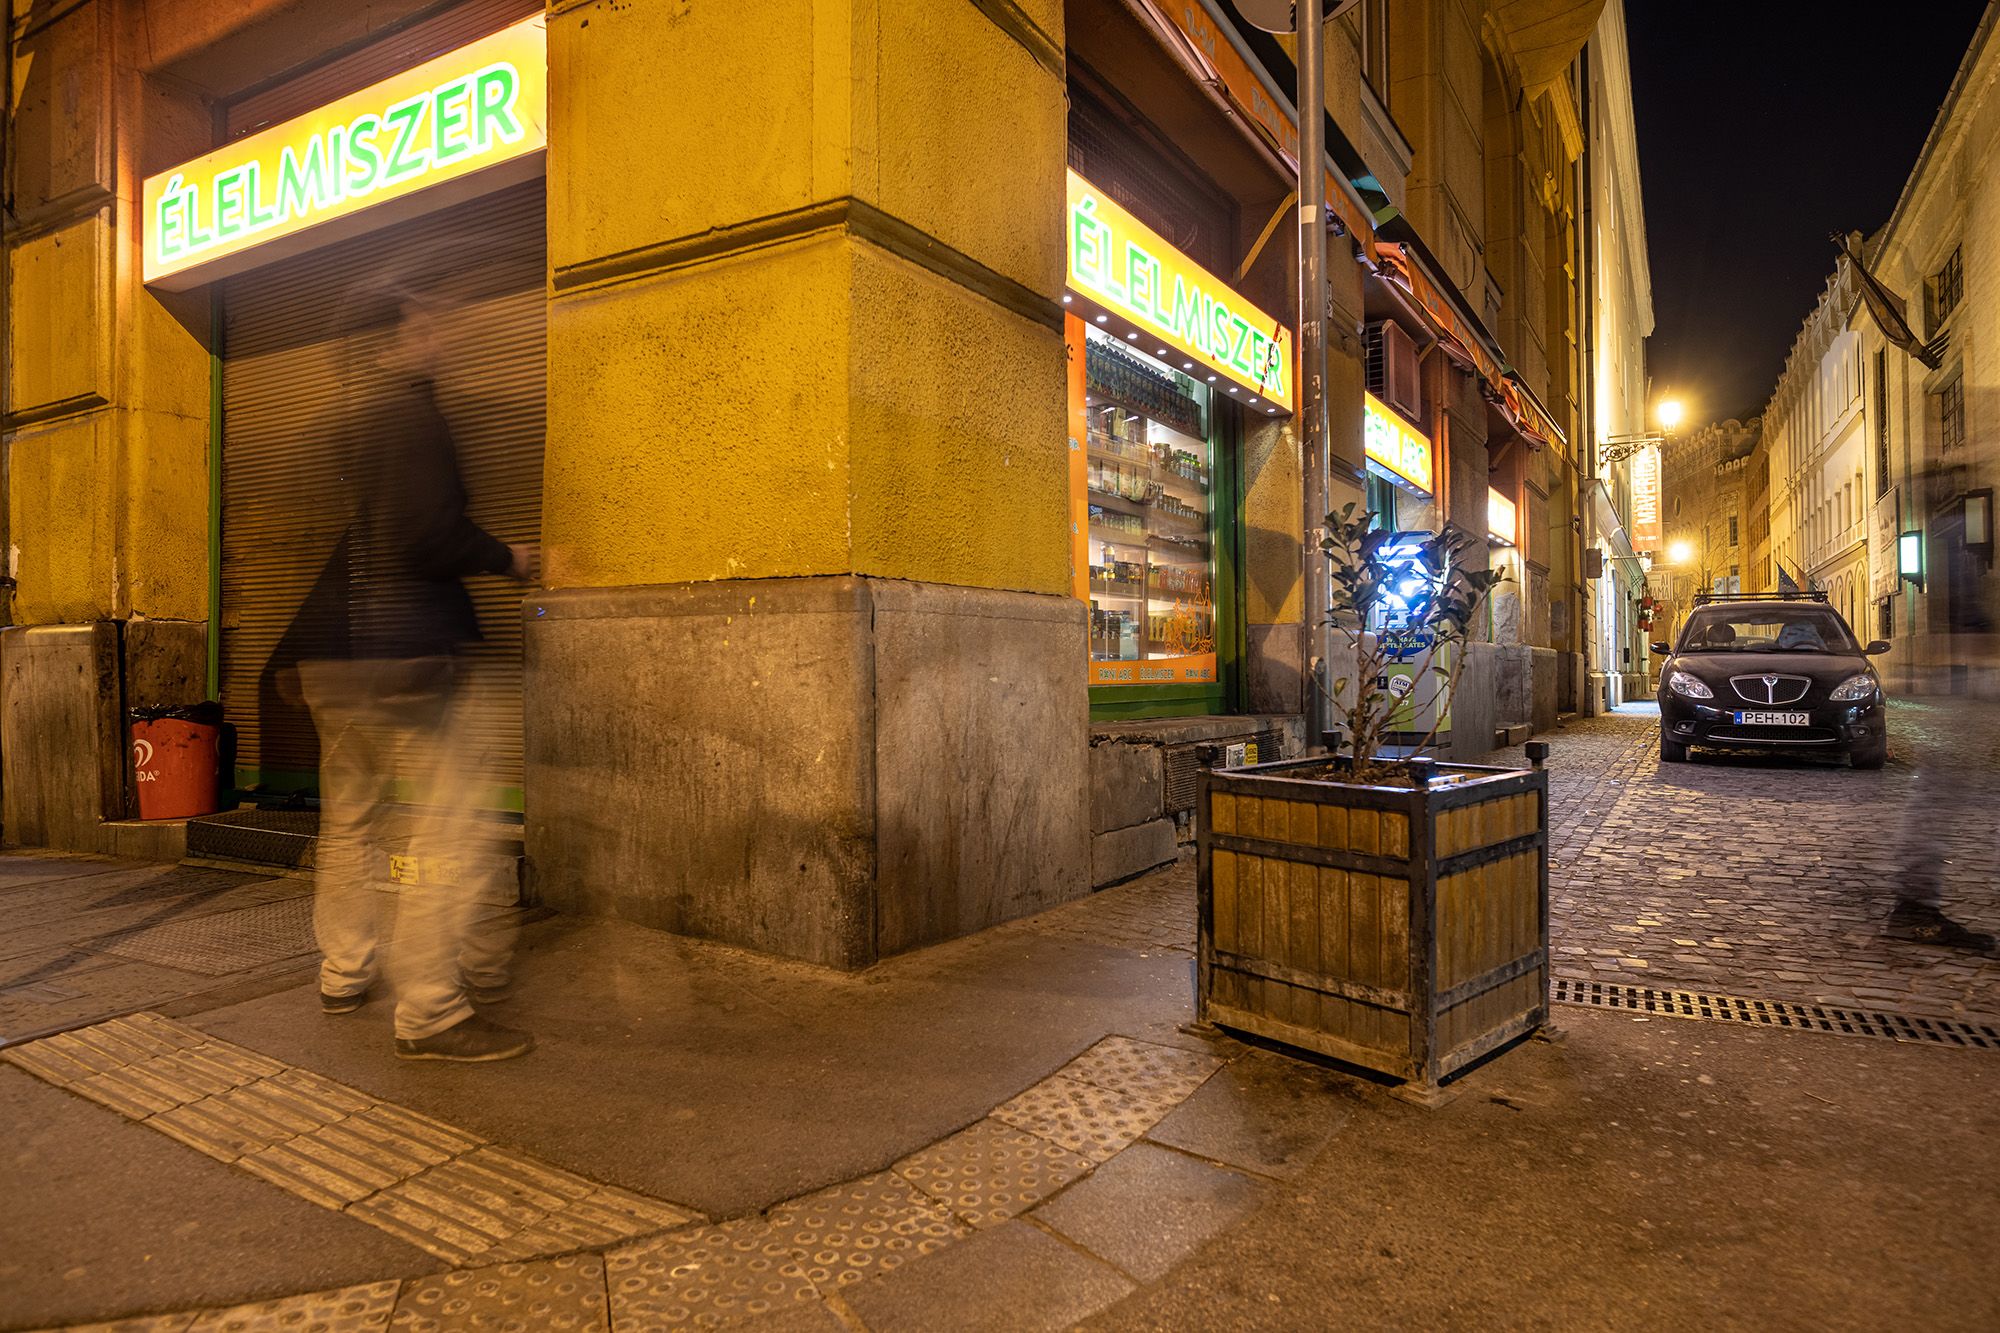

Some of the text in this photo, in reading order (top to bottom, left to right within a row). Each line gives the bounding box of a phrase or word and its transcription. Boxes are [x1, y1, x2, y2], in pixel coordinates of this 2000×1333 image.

[160, 66, 518, 258] ÉLELMISZER
[1073, 198, 1283, 394] ÉLELMISZER
[1744, 712, 1806, 725] PEH-102
